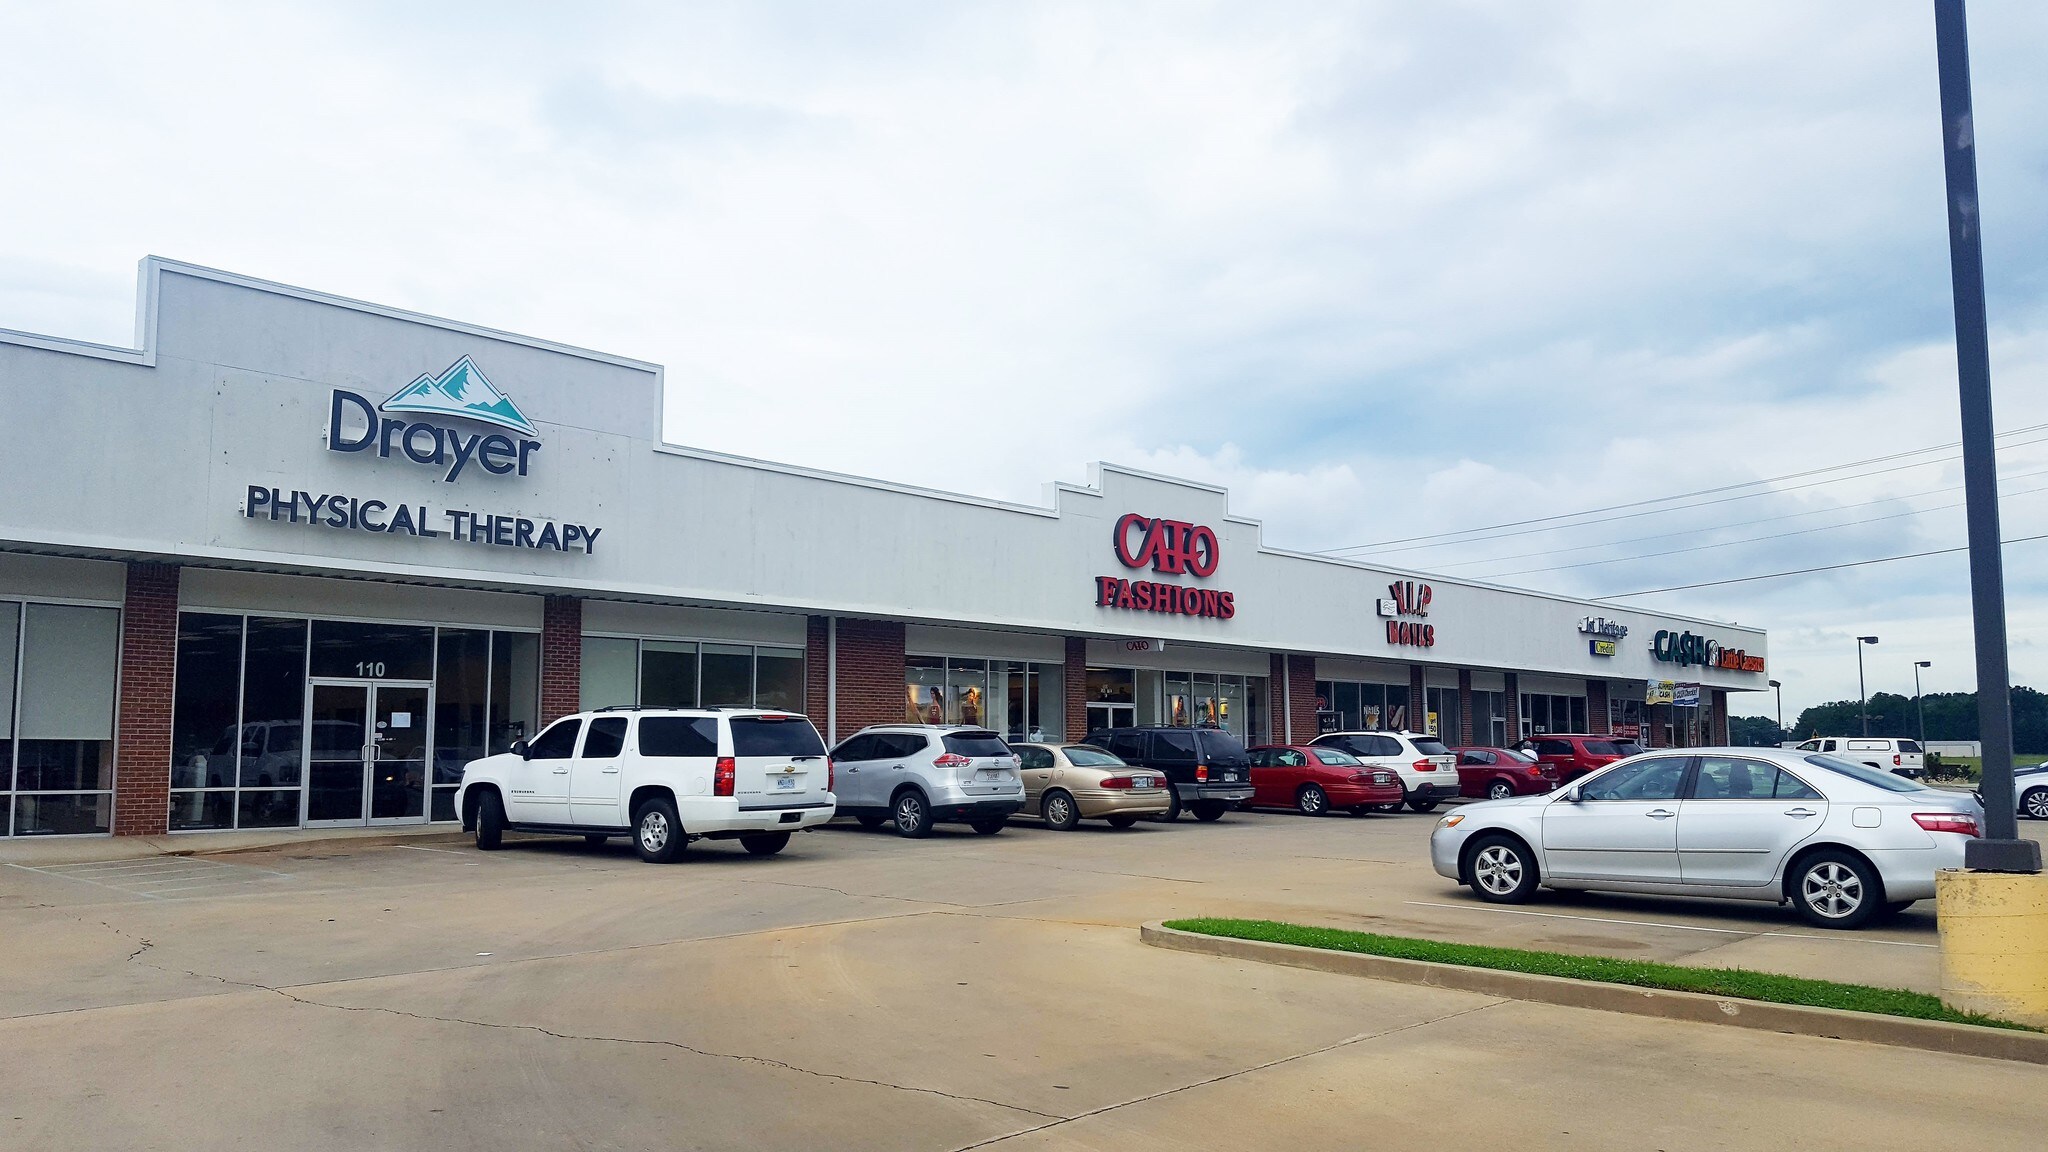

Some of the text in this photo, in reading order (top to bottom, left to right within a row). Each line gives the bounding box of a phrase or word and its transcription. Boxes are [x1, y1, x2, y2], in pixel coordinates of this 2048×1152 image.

[326, 389, 542, 483] Drayer
[245, 485, 602, 554] PHYSICAL THERAPY
[1113, 513, 1219, 577] CATO
[1095, 576, 1235, 619] FASHIONS
[1386, 620, 1434, 647] NAILS
[1596, 617, 1628, 639] Heritage
[1126, 640, 1149, 651] CATO
[1596, 642, 1614, 655] Credit
[356, 661, 385, 677] 110
[1720, 646, 1765, 672] Little Caesars
[1363, 706, 1380, 715] NAILS
